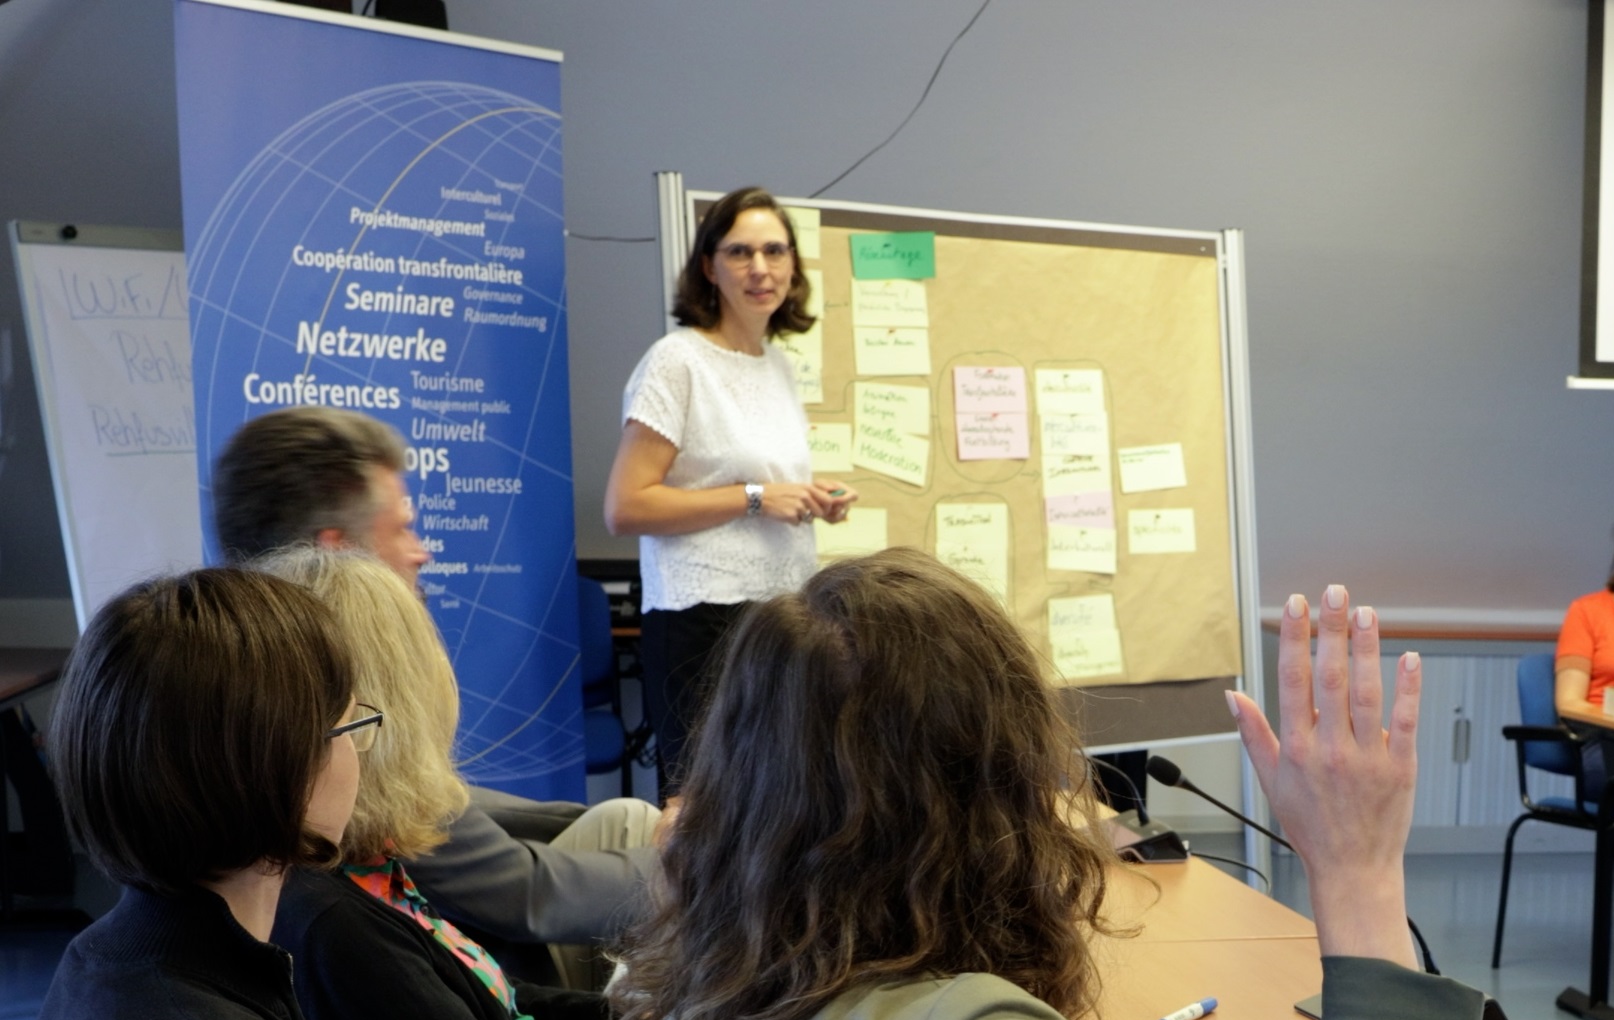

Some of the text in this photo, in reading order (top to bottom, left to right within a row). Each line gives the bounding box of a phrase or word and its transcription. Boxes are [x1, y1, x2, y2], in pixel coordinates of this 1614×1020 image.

[350, 207, 486, 237] Projektmanagement
[484, 241, 525, 262] Europa
[292, 245, 523, 285] Coopération transfrontalière
[345, 282, 455, 318] Seminare
[463, 285, 523, 304] Governance
[463, 307, 547, 333] Raumordnung
[296, 320, 447, 362] Netzwerke
[243, 373, 400, 409] Conférences
[410, 370, 485, 393] Tourisme
[411, 397, 512, 415] Management public
[411, 416, 486, 442] Umwelt
[446, 472, 522, 497] Jeunesse
[418, 493, 456, 511] Police
[423, 514, 490, 531] Wirtschaft
[418, 560, 469, 577] olloques
